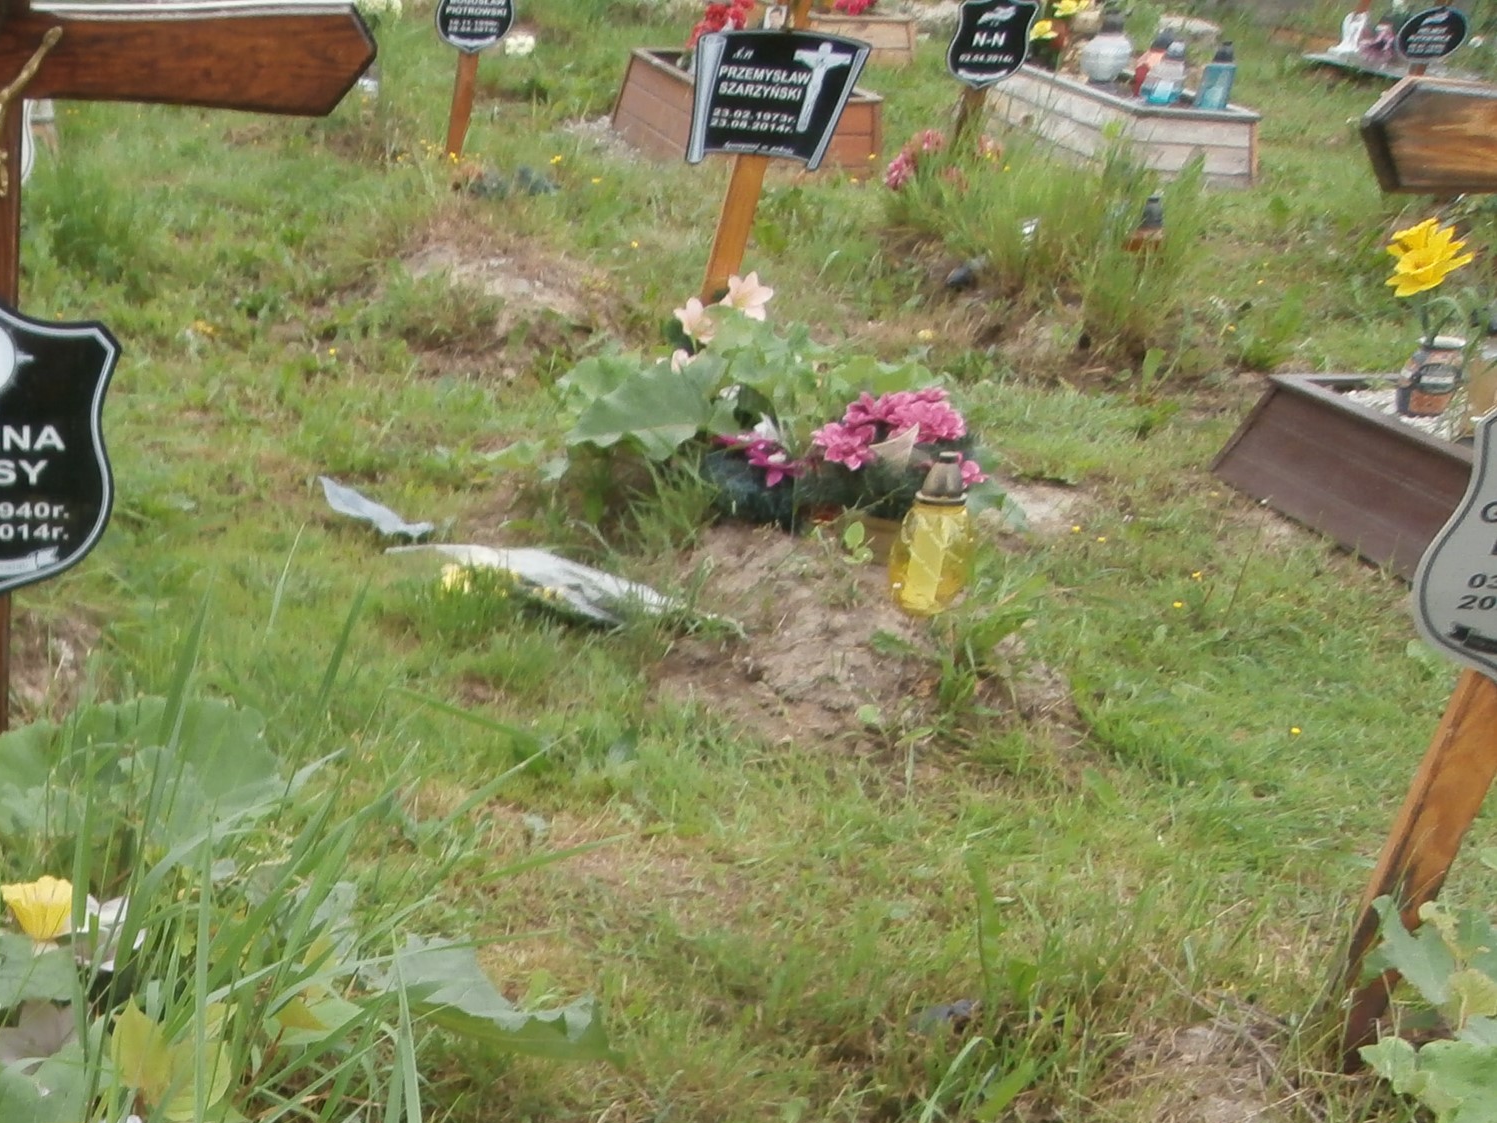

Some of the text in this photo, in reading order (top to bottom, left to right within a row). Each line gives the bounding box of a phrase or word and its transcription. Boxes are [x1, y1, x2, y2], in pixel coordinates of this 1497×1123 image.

[446, 6, 507, 16] PIOTROWSKI
[972, 32, 1006, 47] N-N
[719, 66, 811, 85] PRZEMYSŁAW
[719, 82, 802, 100] SZARZYŃSKI
[713, 107, 796, 124] 23.02.1973r.
